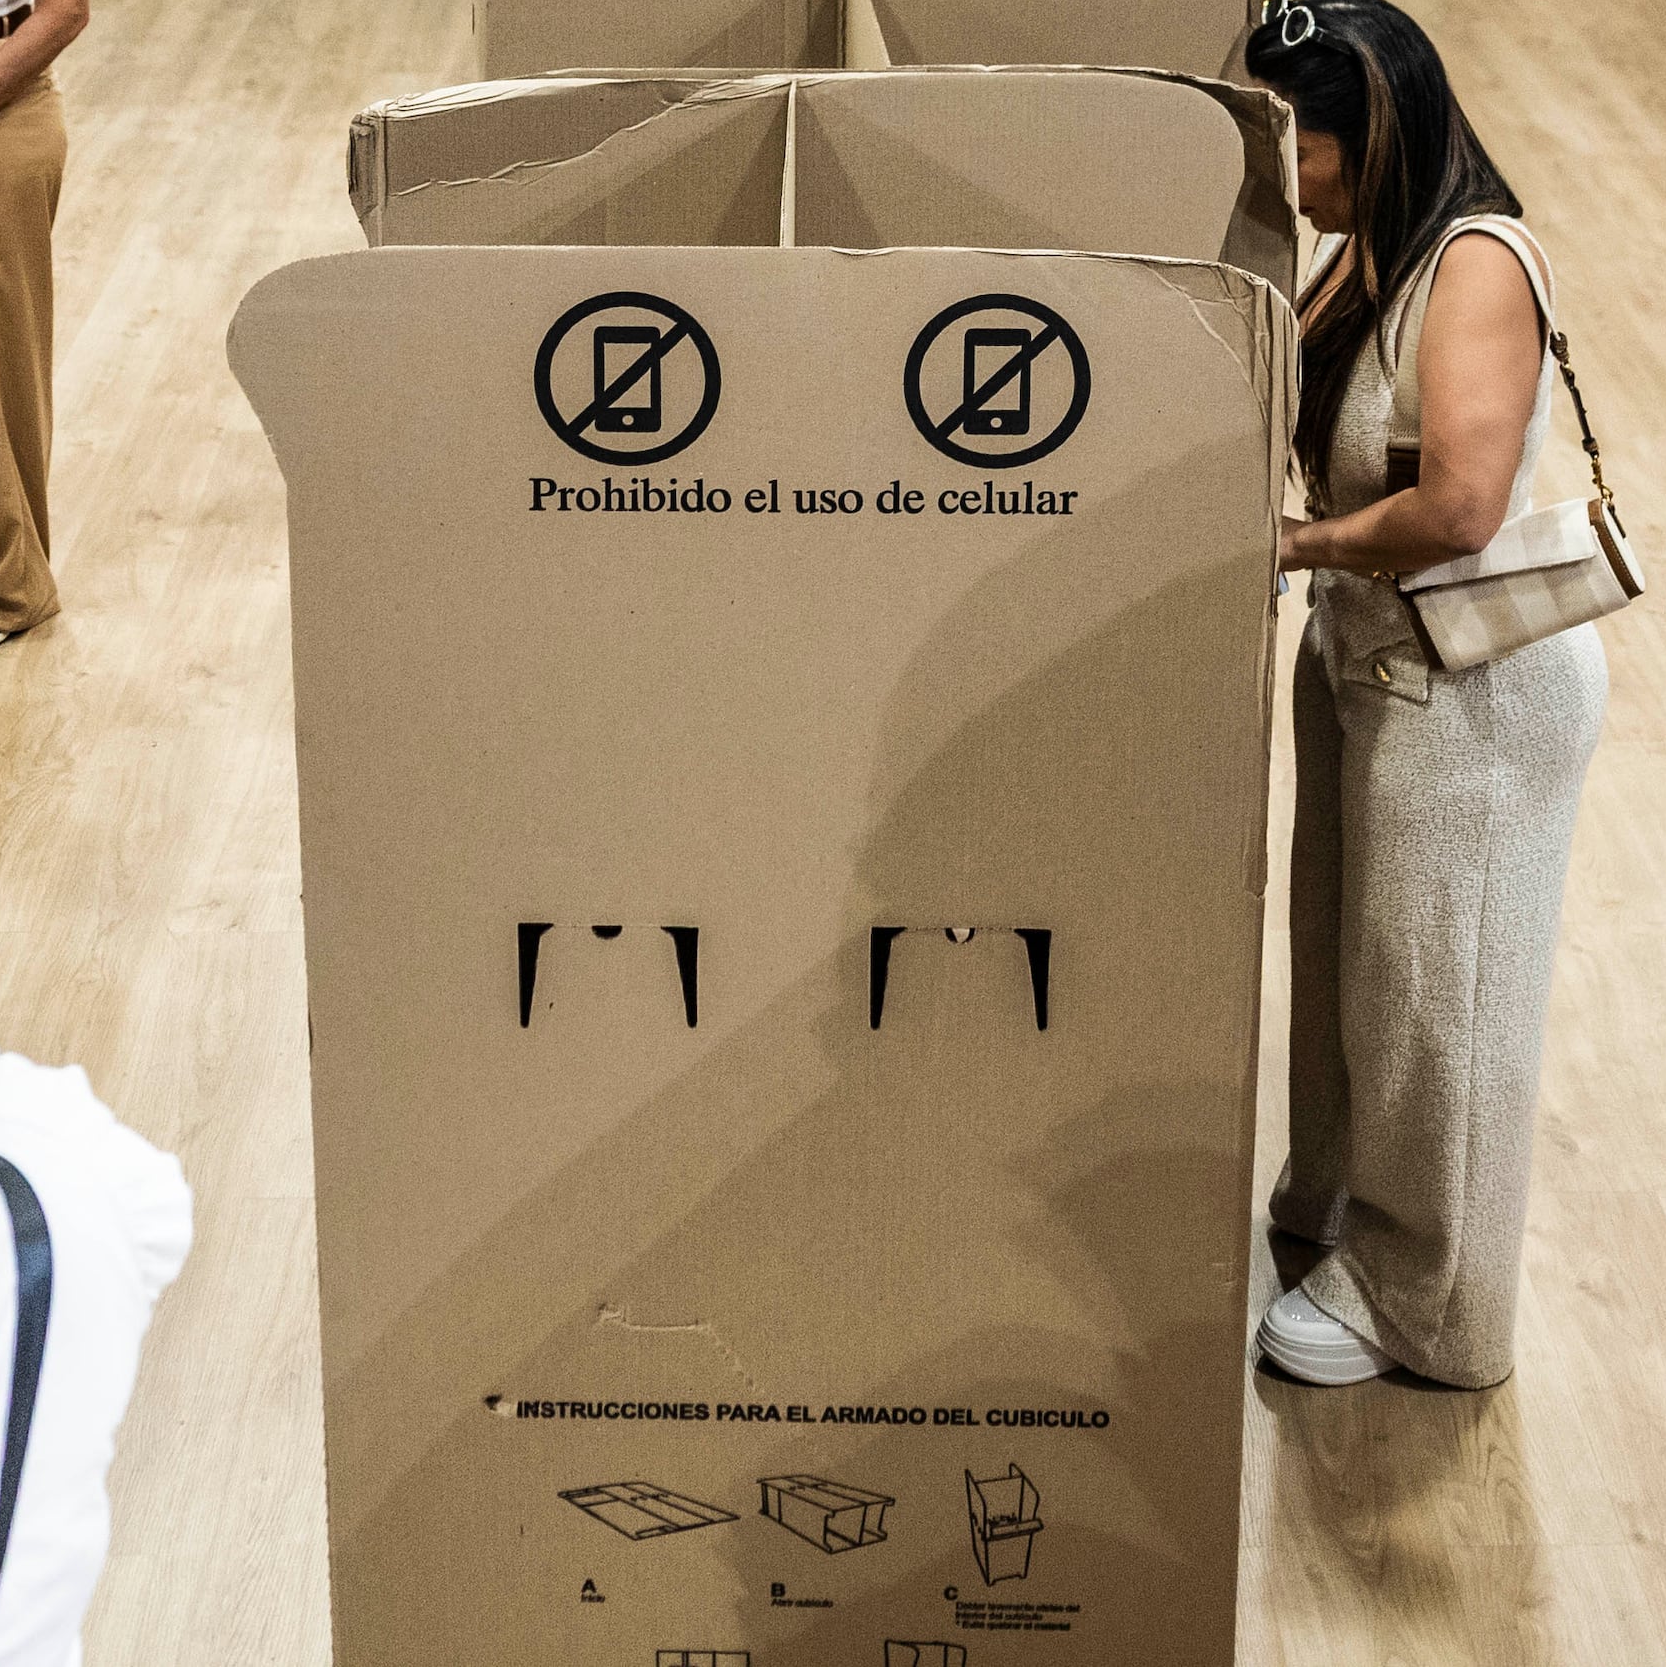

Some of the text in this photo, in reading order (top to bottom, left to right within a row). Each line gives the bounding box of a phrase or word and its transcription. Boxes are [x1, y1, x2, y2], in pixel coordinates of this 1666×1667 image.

[528, 477, 1079, 516] Prohibido el uso de celular
[517, 1400, 1111, 1430] INSTRUCCIONES PARA EL ARMADO DEL CUBICULO
[581, 1578, 597, 1594] A
[770, 1582, 786, 1598] B
[943, 1585, 958, 1602] C
